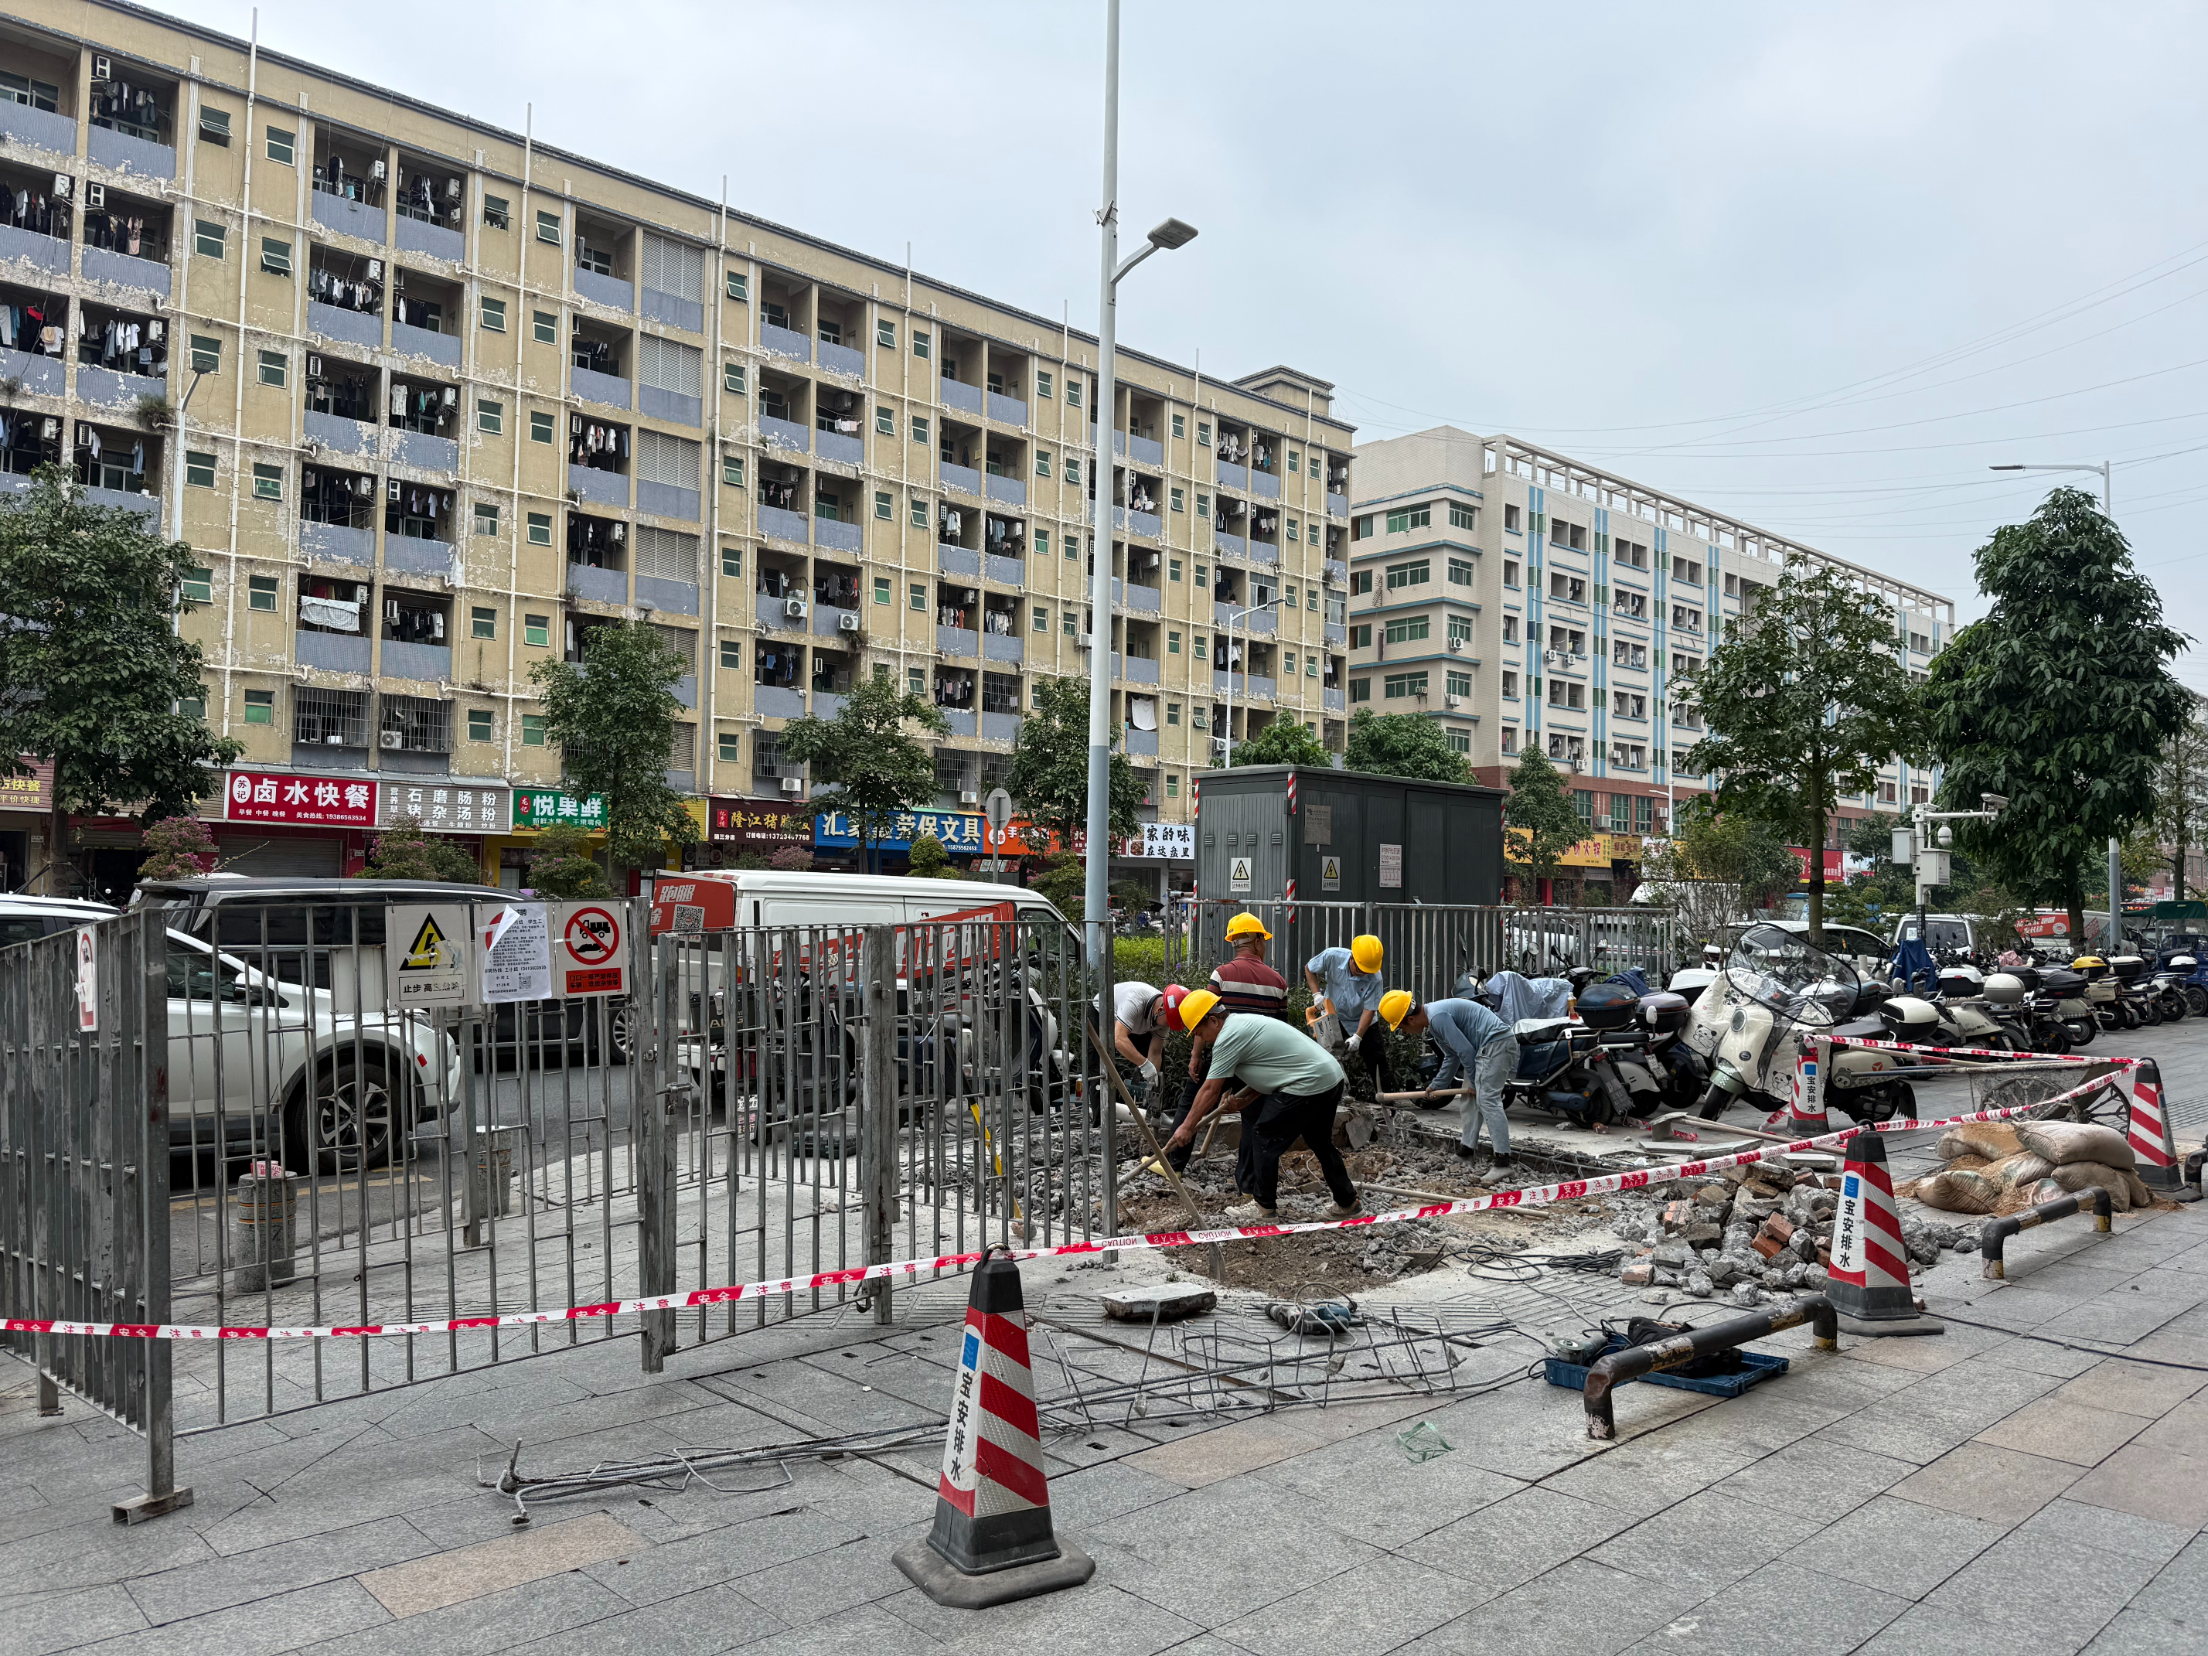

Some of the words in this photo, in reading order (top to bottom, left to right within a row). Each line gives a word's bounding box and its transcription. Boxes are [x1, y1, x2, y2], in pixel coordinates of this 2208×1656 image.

[237, 780, 247, 800] 苏记
[254, 778, 370, 809] 卤水快餐
[407, 788, 496, 806] 石磨肠粉
[407, 804, 496, 821] 猪杂汤粉
[533, 795, 602, 818] 悦果鲜
[1147, 825, 1190, 843] 家的味
[1147, 845, 1190, 857] 在这盘里
[658, 885, 696, 903] 跑腿
[403, 984, 421, 993] 止步
[1807, 1076, 1817, 1113] 宝安排水
[1684, 1165, 1703, 1176] SAFE
[1711, 1160, 1732, 1169] CAUTION
[1625, 1180, 1644, 1188] SAFE
[1839, 1200, 1856, 1268] 宝安排水
[880, 1263, 916, 1277] 注意
[821, 1273, 853, 1286] 安全
[756, 1281, 792, 1296] 注意
[697, 1291, 730, 1304] 安全
[633, 1299, 669, 1311] 注意
[14, 1323, 41, 1332] 安全
[63, 1324, 95, 1334] 注意
[119, 1328, 147, 1337] 安全
[169, 1329, 202, 1338] 注意
[950, 1371, 973, 1482] 宝安排水
